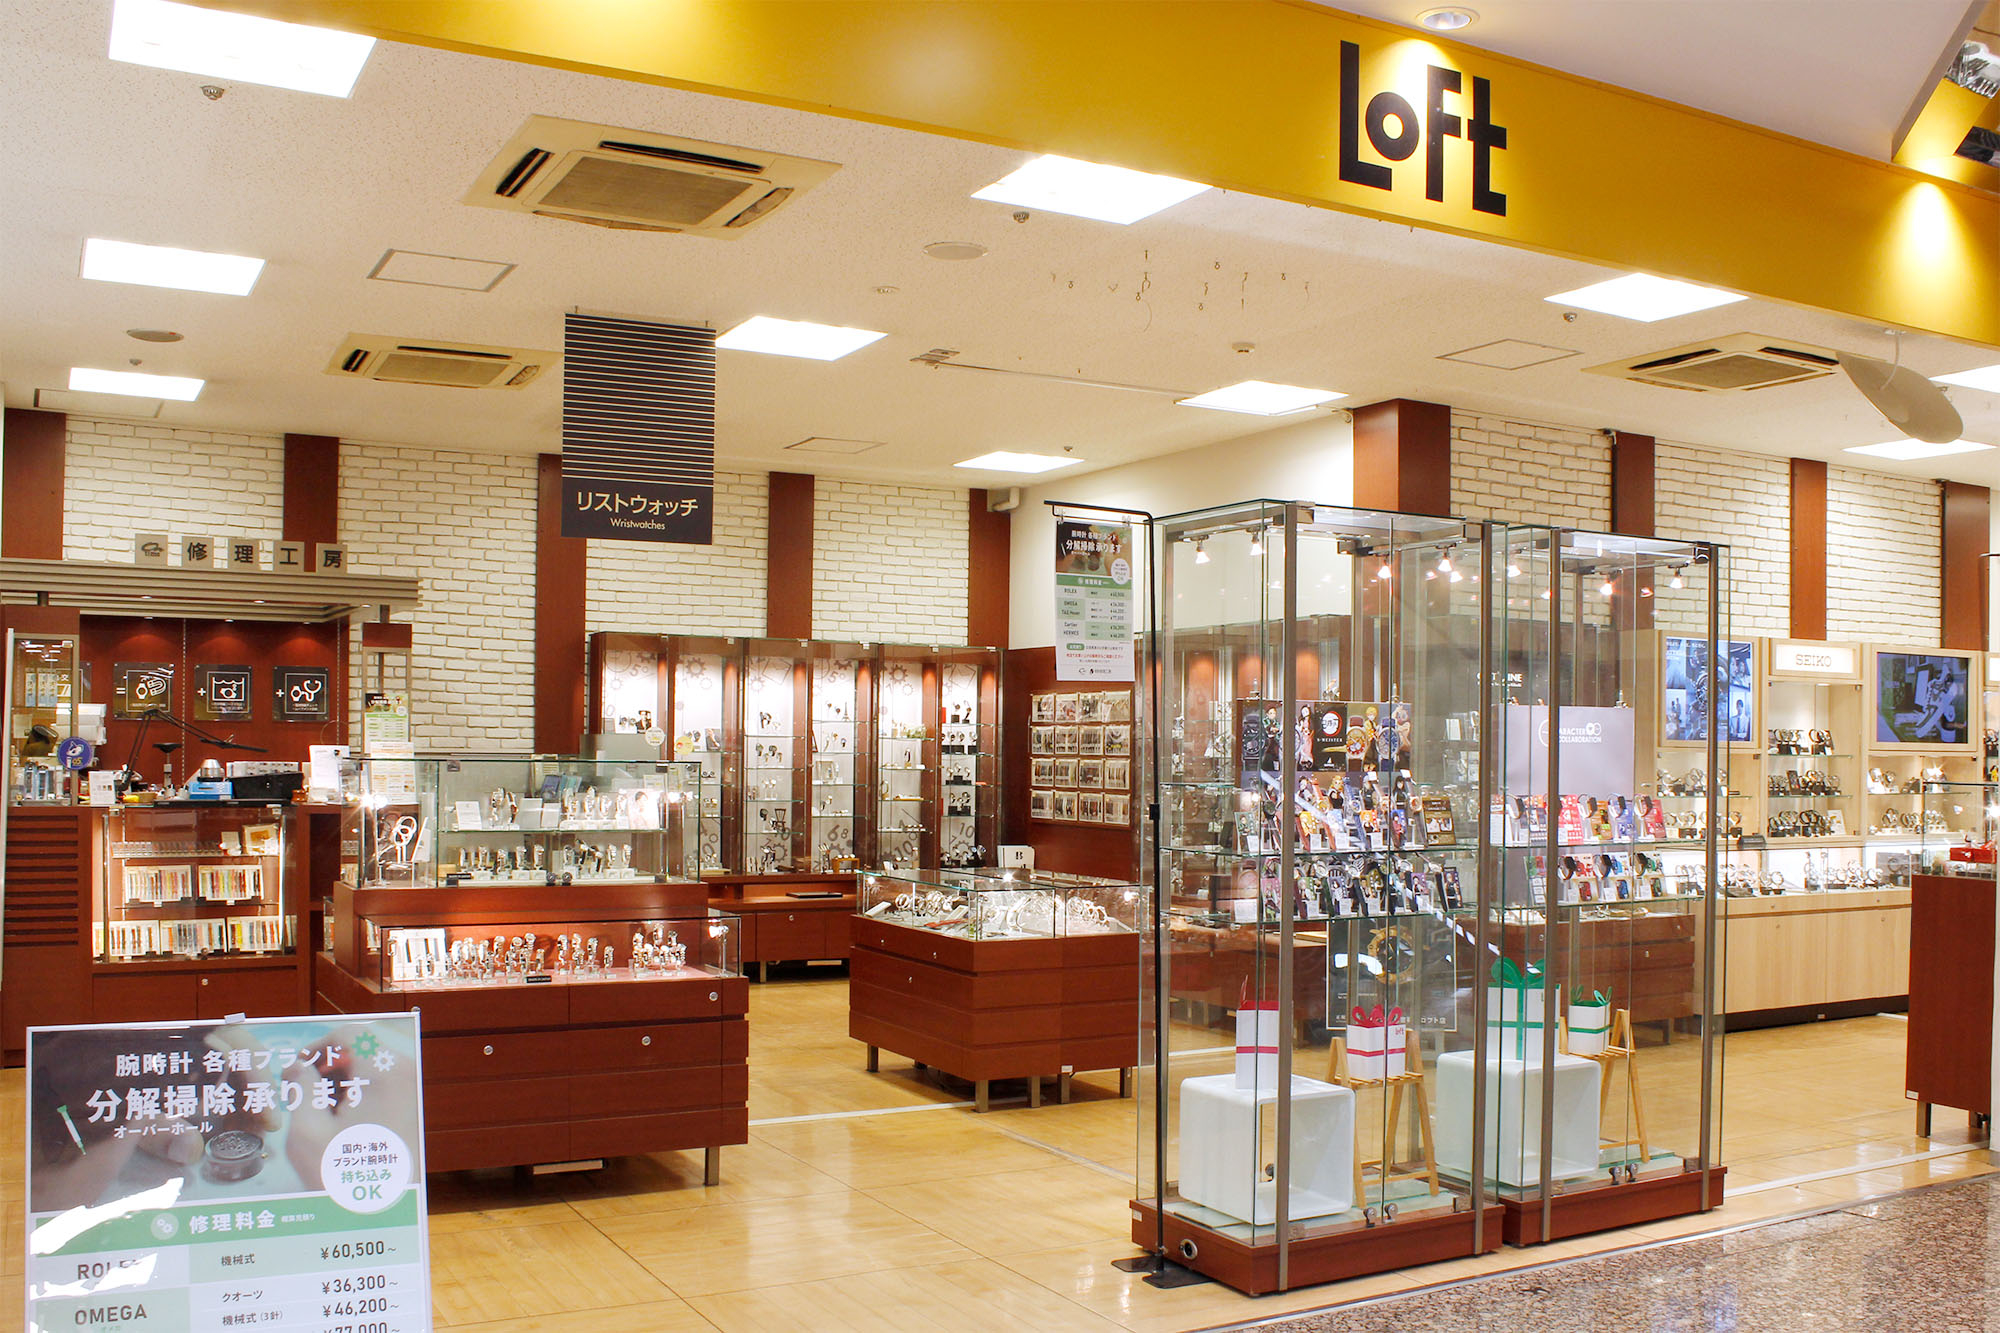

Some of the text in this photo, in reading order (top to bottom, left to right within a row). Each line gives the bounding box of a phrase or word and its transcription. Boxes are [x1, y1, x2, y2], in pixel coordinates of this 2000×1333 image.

[577, 491, 699, 517] リストウォッチ
[610, 517, 666, 530] Wristwatches
[187, 541, 342, 569] 修理工房
[1796, 654, 1832, 668] SEIKO
[116, 1045, 342, 1077] 腕時計 各種ブランド
[86, 1076, 370, 1124] 分解掃除承ります
[114, 1121, 213, 1139] オーバーホール
[342, 1142, 389, 1155] 国内・海外
[333, 1154, 399, 1168] ブランド腕時計
[341, 1168, 392, 1184] 持ち込み
[353, 1184, 383, 1201] OK
[189, 1209, 276, 1235] 修理料金
[221, 1253, 256, 1266] 機械式
[222, 1290, 264, 1303] クオーツ
[74, 1303, 148, 1326] OMEGA
